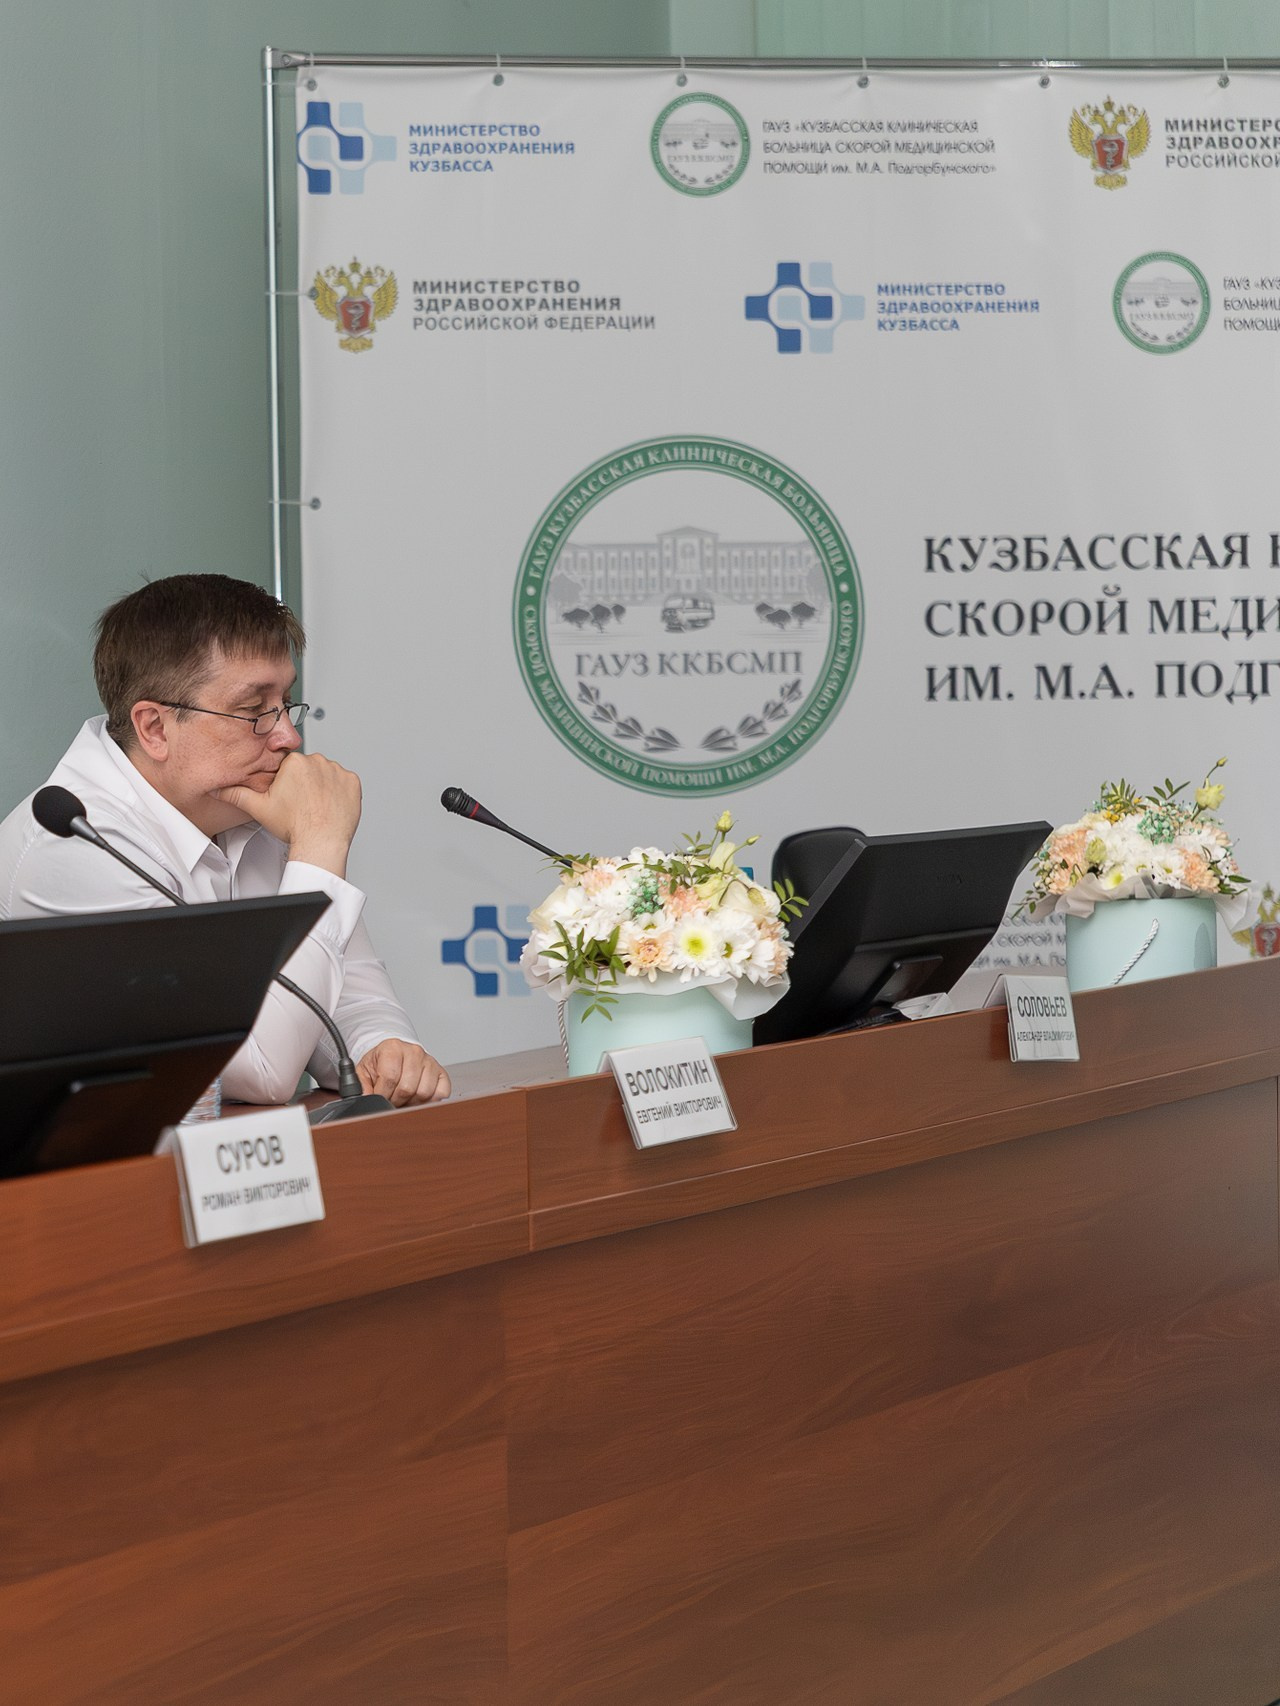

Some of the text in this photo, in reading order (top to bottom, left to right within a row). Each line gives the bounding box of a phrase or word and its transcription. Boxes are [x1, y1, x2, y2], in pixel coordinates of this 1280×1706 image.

[408, 124, 541, 137] МИНИСТЕРСТВО
[762, 121, 791, 133] ГАУЗ
[887, 121, 980, 133] КЛИНИЧЕСКАЯ
[408, 142, 576, 156] ЗДРАВООХРАНЕНИЯ
[763, 139, 996, 155] БОЛЬНИЦА СКОРОЙ МЕДИЦИНСКОЙ
[409, 160, 495, 173] КУЗБАССА
[763, 162, 828, 175] ПОМОЩИ
[412, 280, 582, 294] МИНИСТЕРСТВО
[877, 283, 1006, 297] МИНИСТЕРСТВО
[1223, 277, 1250, 290] ГАУЗ
[413, 297, 621, 313] ЗДРАВООХРАНЕНИЯ
[877, 300, 1040, 315] ЗДРАВООХРАНЕНИЯ
[413, 314, 656, 332] РОССИЙСКОЙ ФЕДЕРАЦИИ
[877, 318, 960, 331] КУЗБАССА
[528, 447, 848, 579] ГАУЗ КУЗБАССКАЯ КЛИНИЧЕСКАЯ БОЛЬНИЦА
[924, 532, 1250, 573] КУЗБАССКАЯ
[924, 584, 1280, 641] СКОРОЙ МЕДИ
[574, 650, 804, 678] ГАУЗ ККБСМП
[925, 660, 1280, 705] ИМ. М.А. ПОДГ
[1016, 995, 1068, 1018] СОЛОВЬЕВ
[625, 1059, 713, 1097] ВОЛОКИТИН
[636, 1095, 724, 1124] ЕВГЕНИЙ ВИКТОРОВИЧ
[216, 1135, 285, 1174] СУРОВ
[201, 1176, 312, 1212] РОМАН ВИКТОРОВИЧ
